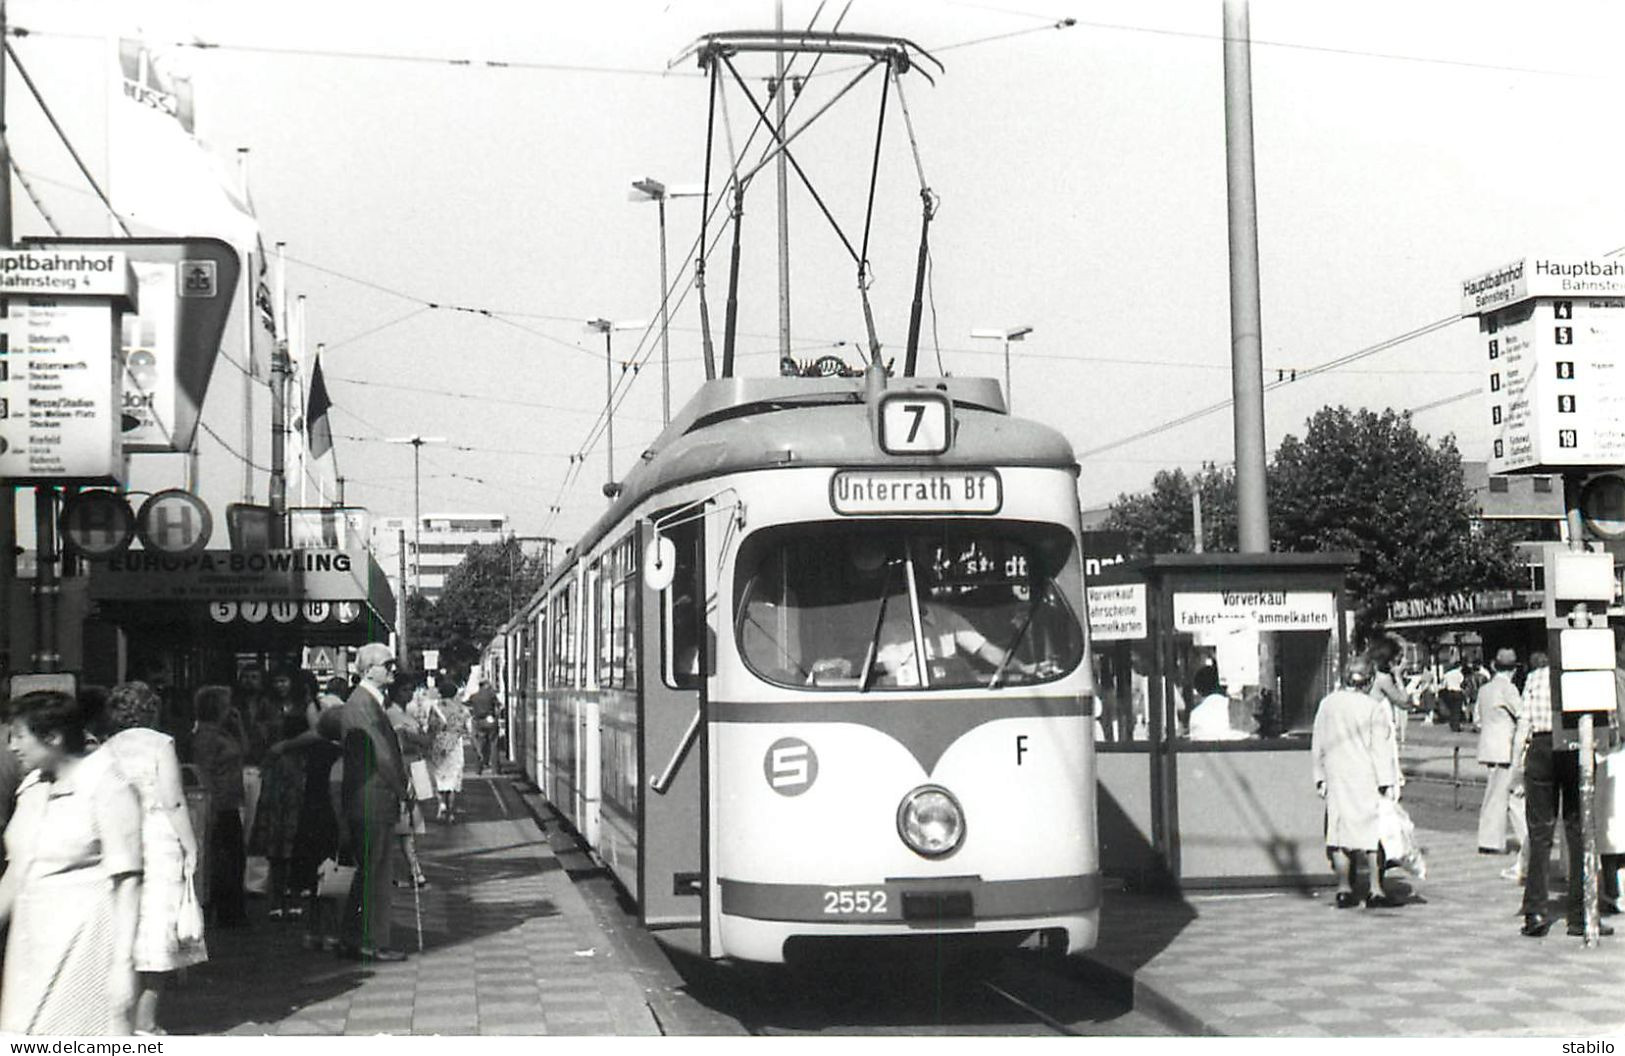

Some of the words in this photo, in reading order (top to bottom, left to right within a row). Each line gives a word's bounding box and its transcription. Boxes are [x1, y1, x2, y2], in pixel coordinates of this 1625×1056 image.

[0, 253, 114, 273] ptbahnhof
[1464, 261, 1524, 298] Hauptbahnhof
[1476, 288, 1510, 308] Bahnsteig
[1560, 328, 1568, 344] 5
[1562, 362, 1570, 379] 8
[1563, 396, 1571, 413] 9
[903, 404, 927, 443] 7
[1560, 430, 1576, 448] 19
[837, 476, 951, 501] Unterrath
[964, 476, 986, 500] Bf
[157, 505, 193, 546] H
[1221, 589, 1288, 606] Vorverkauf
[218, 601, 229, 616] 5
[249, 602, 259, 616] 7
[279, 601, 291, 616] 11
[308, 601, 322, 616] 18
[340, 600, 353, 618] K
[1016, 735, 1029, 765] F
[823, 891, 888, 914] 2552
